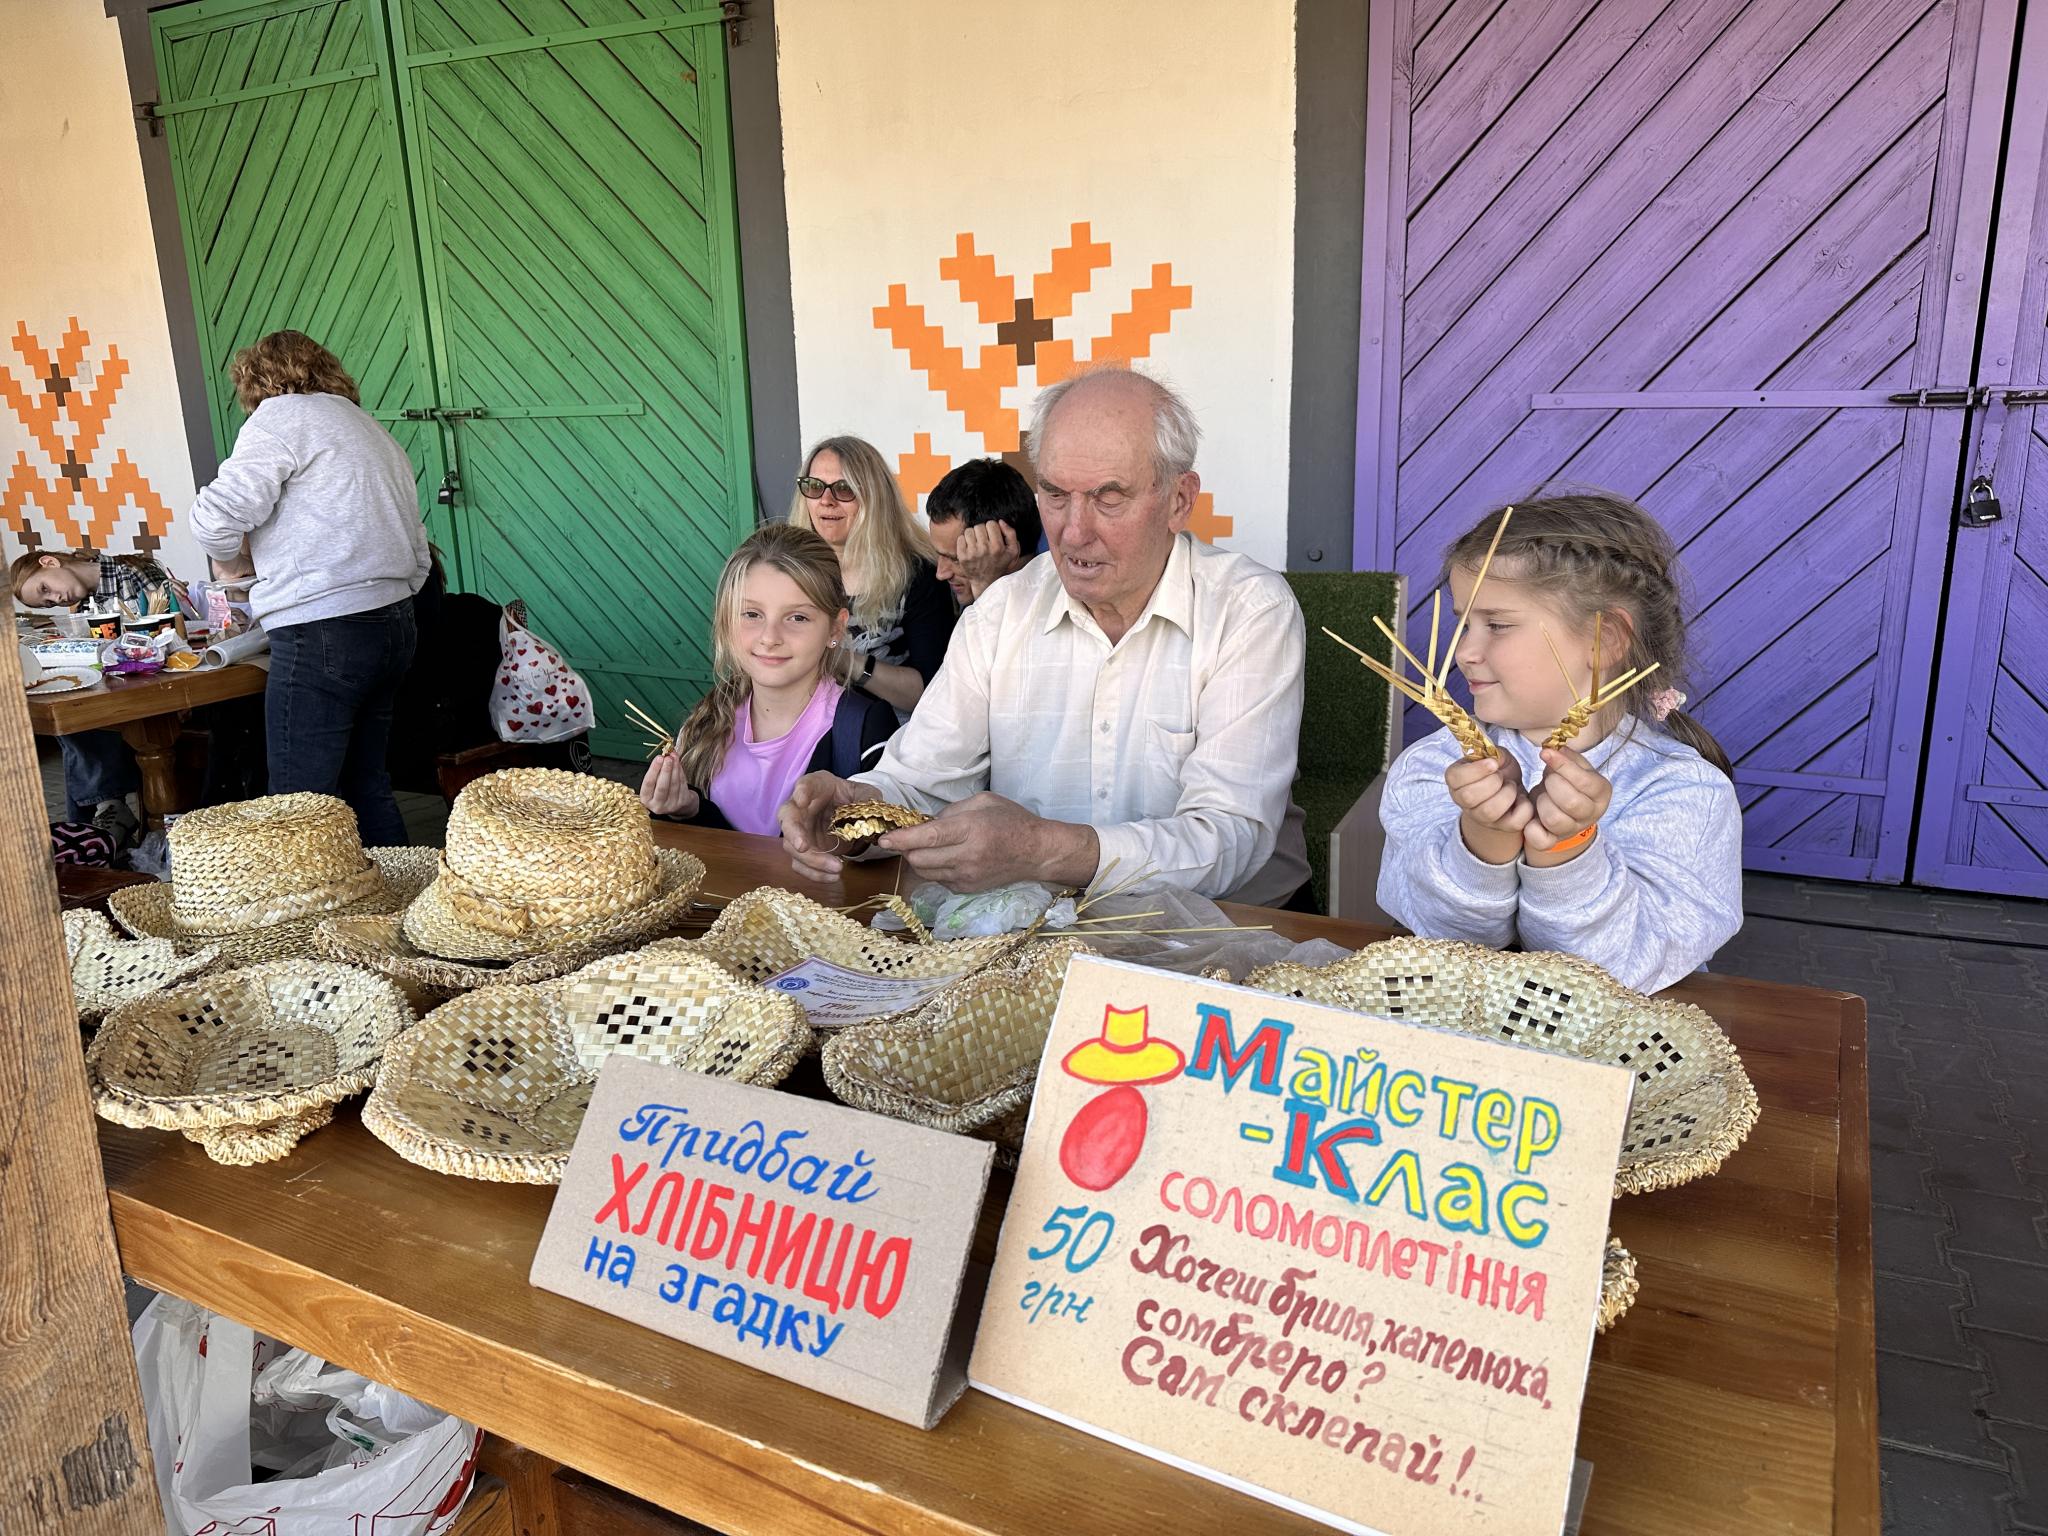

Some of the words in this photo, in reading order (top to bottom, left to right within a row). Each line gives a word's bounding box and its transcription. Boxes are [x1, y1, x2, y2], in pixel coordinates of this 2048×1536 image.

[1184, 1002, 1561, 1174] Майстер
[618, 1104, 881, 1203] Придбай
[594, 1153, 912, 1319] ХЛІБНИЦЮ
[1028, 1206, 1115, 1273] 50
[1130, 1224, 1267, 1306] Хочеш
[584, 1236, 635, 1288] на
[659, 1264, 845, 1357] згадку
[1020, 1281, 1094, 1324] грн
[1122, 1336, 1225, 1407] Сам
